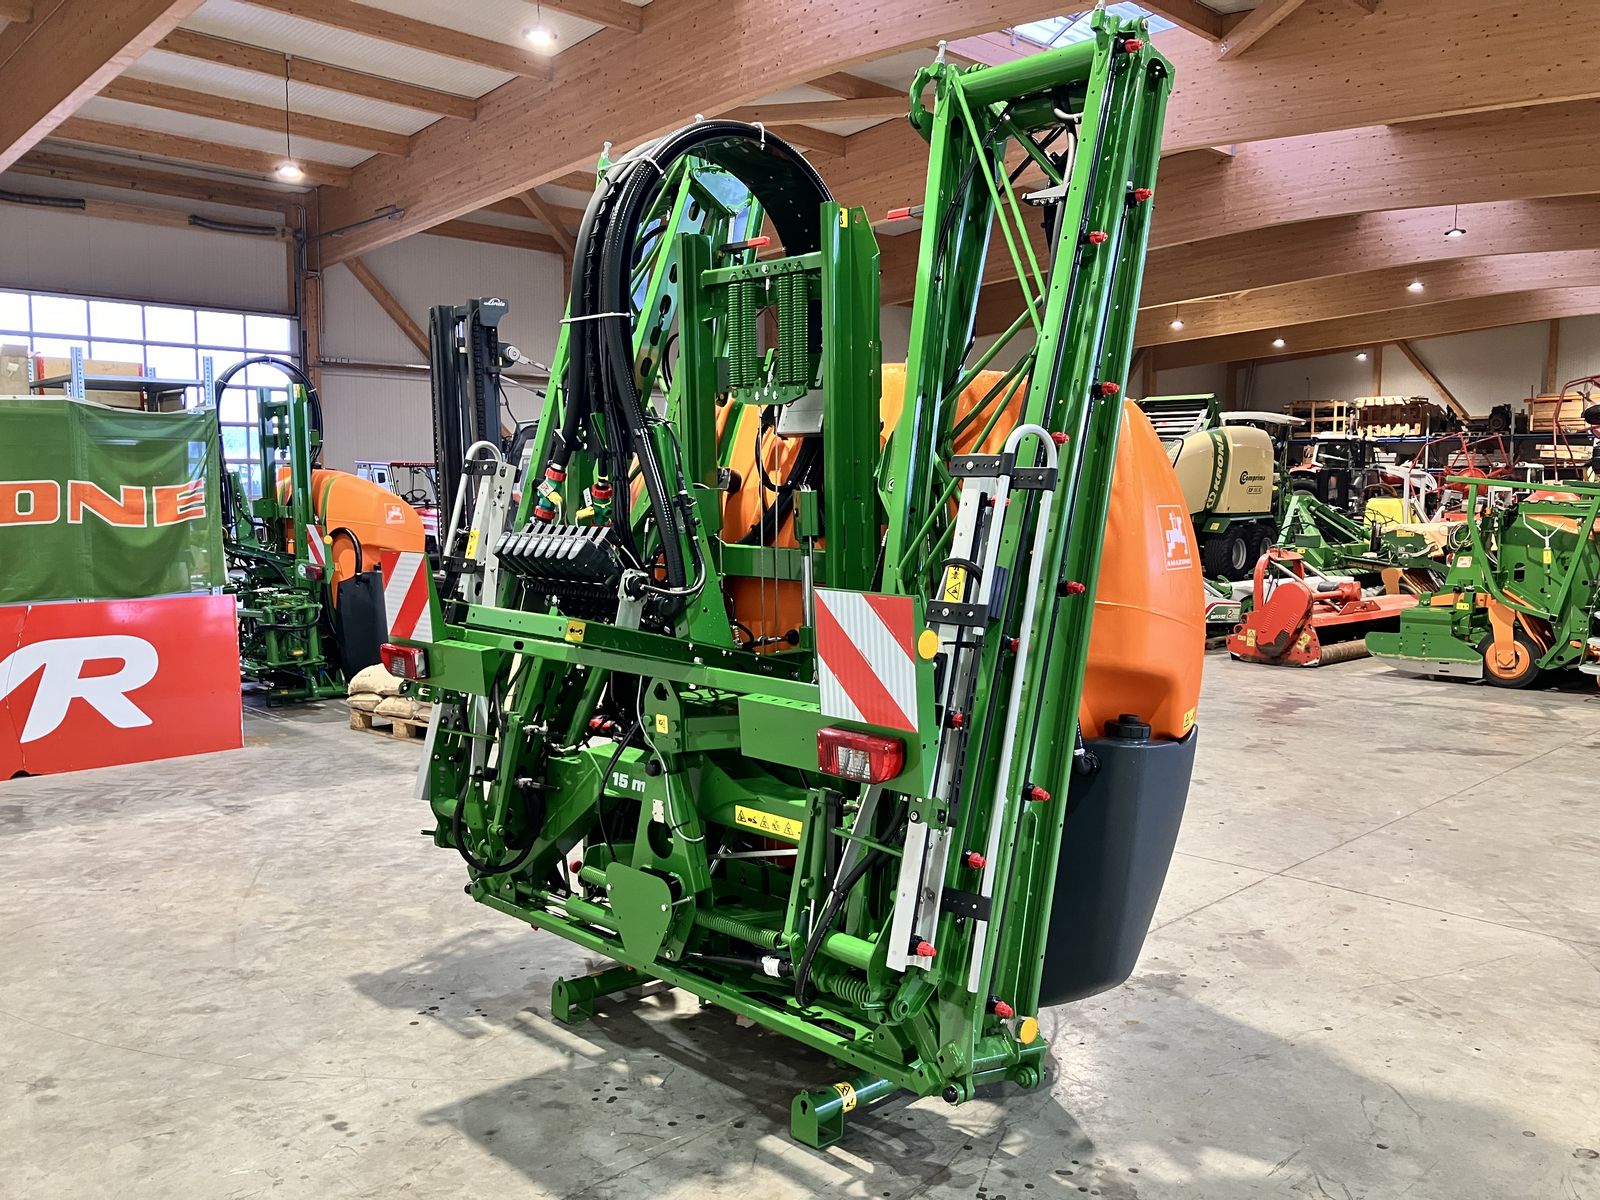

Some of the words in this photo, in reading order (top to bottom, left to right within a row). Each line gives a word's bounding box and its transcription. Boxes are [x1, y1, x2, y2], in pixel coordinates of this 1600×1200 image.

[483, 297, 506, 307] Linde
[1213, 433, 1225, 491] KRONE
[1240, 470, 1266, 485] Comprima
[612, 772, 628, 788] 15
[631, 779, 646, 792] m
